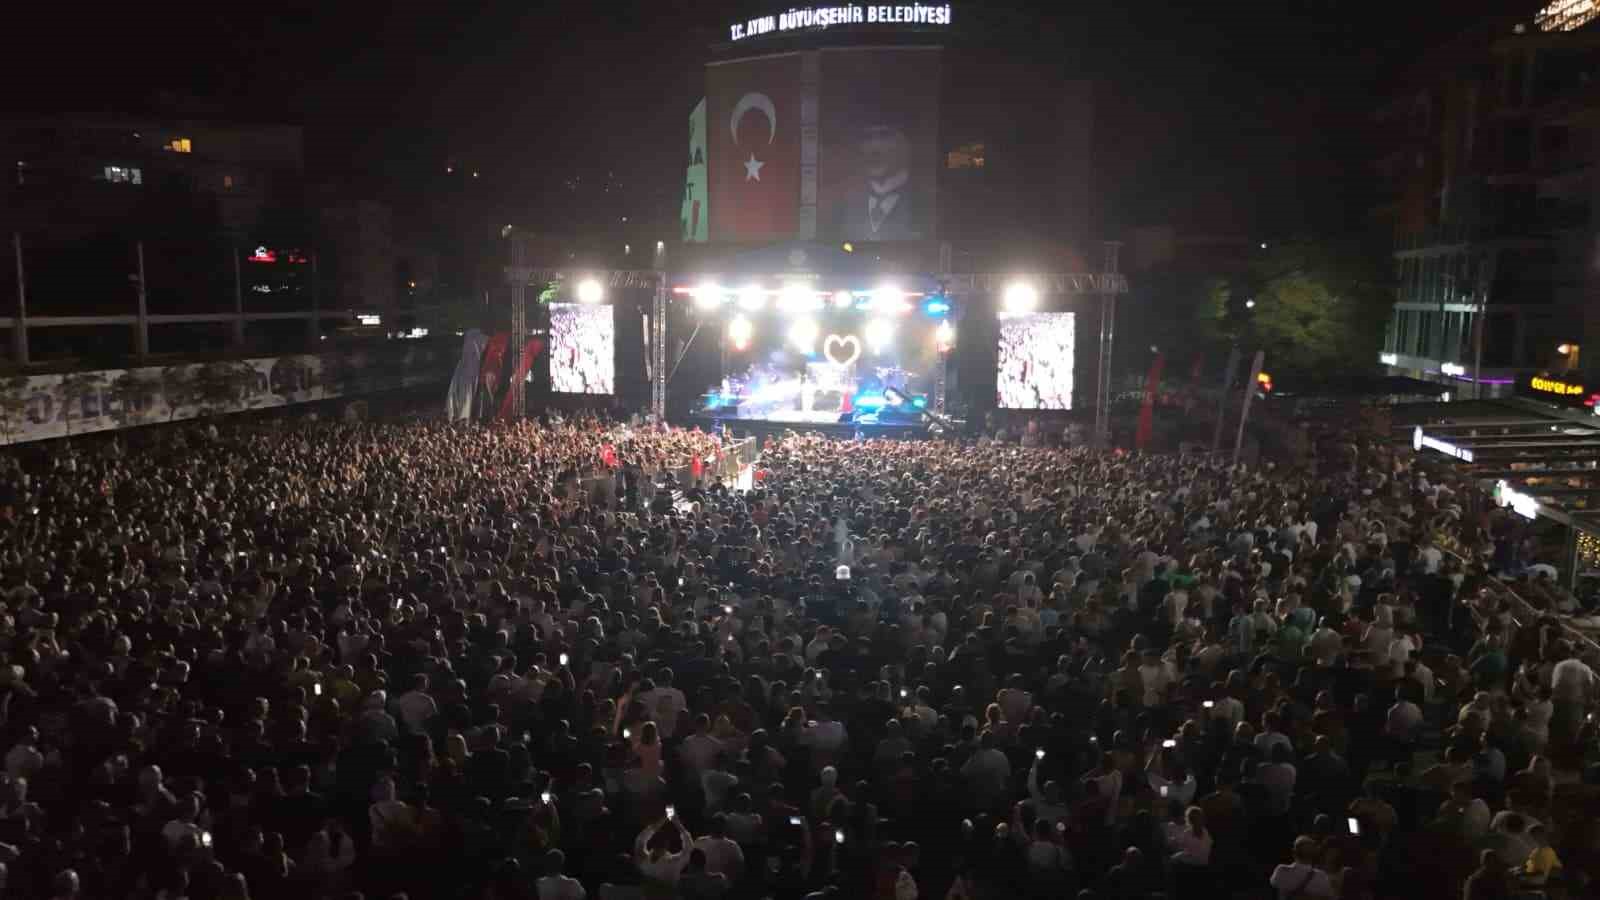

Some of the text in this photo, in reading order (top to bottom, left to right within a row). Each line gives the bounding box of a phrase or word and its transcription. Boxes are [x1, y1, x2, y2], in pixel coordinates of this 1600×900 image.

[731, 24, 746, 40] T.C.
[779, 3, 863, 30] BÜYÜKŞEHİR
[867, 2, 951, 25] BELEDİYESİ
